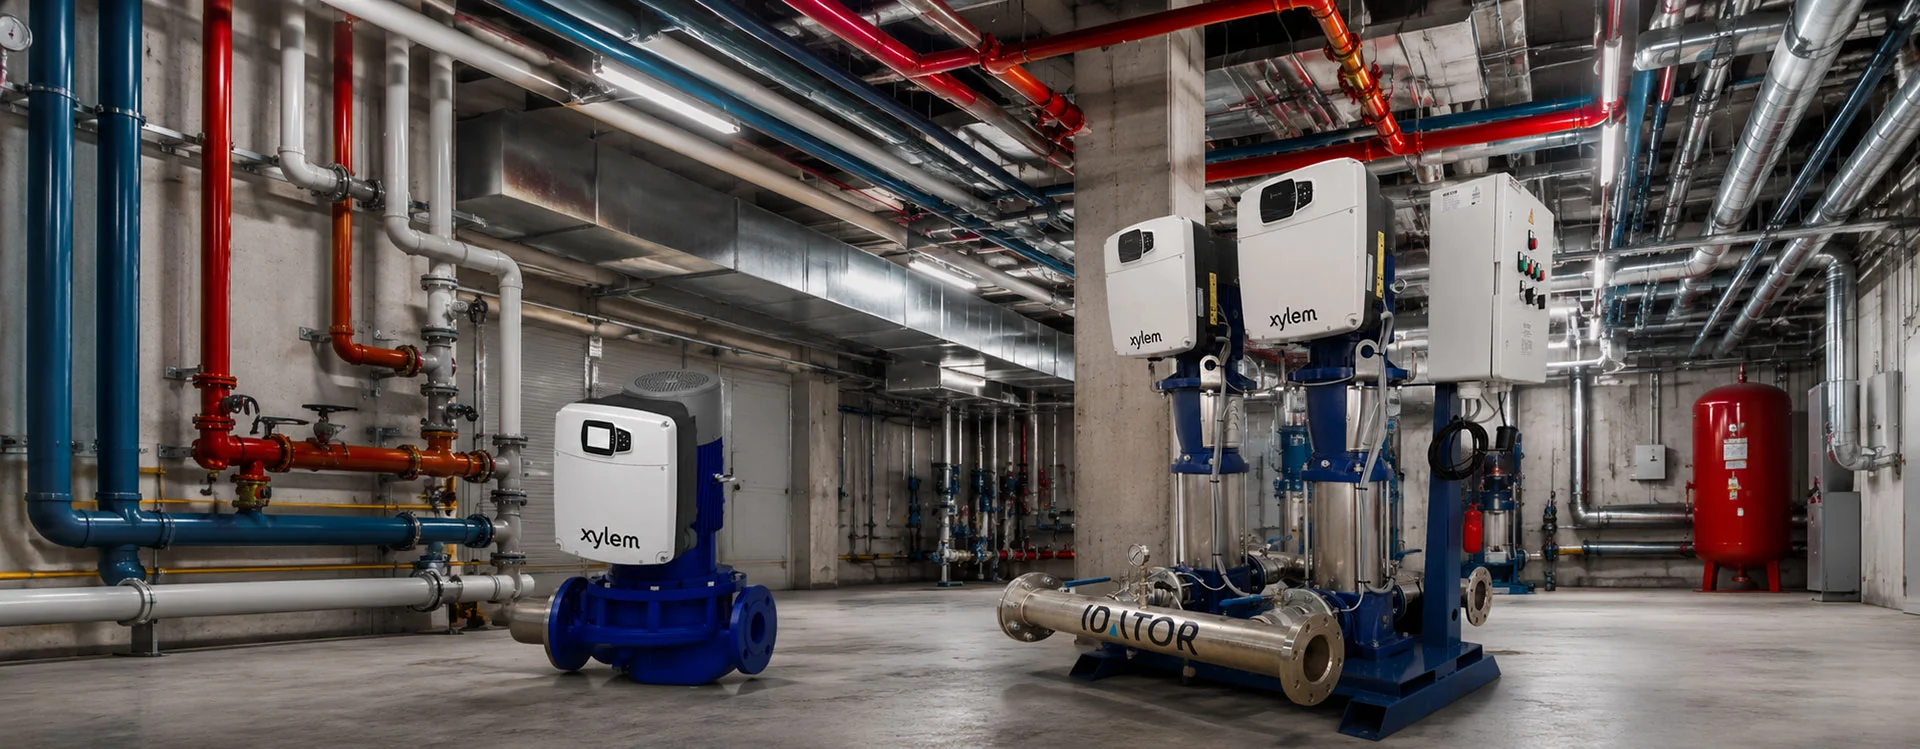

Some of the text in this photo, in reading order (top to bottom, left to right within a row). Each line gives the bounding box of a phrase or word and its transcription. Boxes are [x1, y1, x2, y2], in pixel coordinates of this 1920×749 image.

[1269, 307, 1317, 331] xylem
[1130, 330, 1162, 349] xylem
[580, 526, 641, 549] xylem
